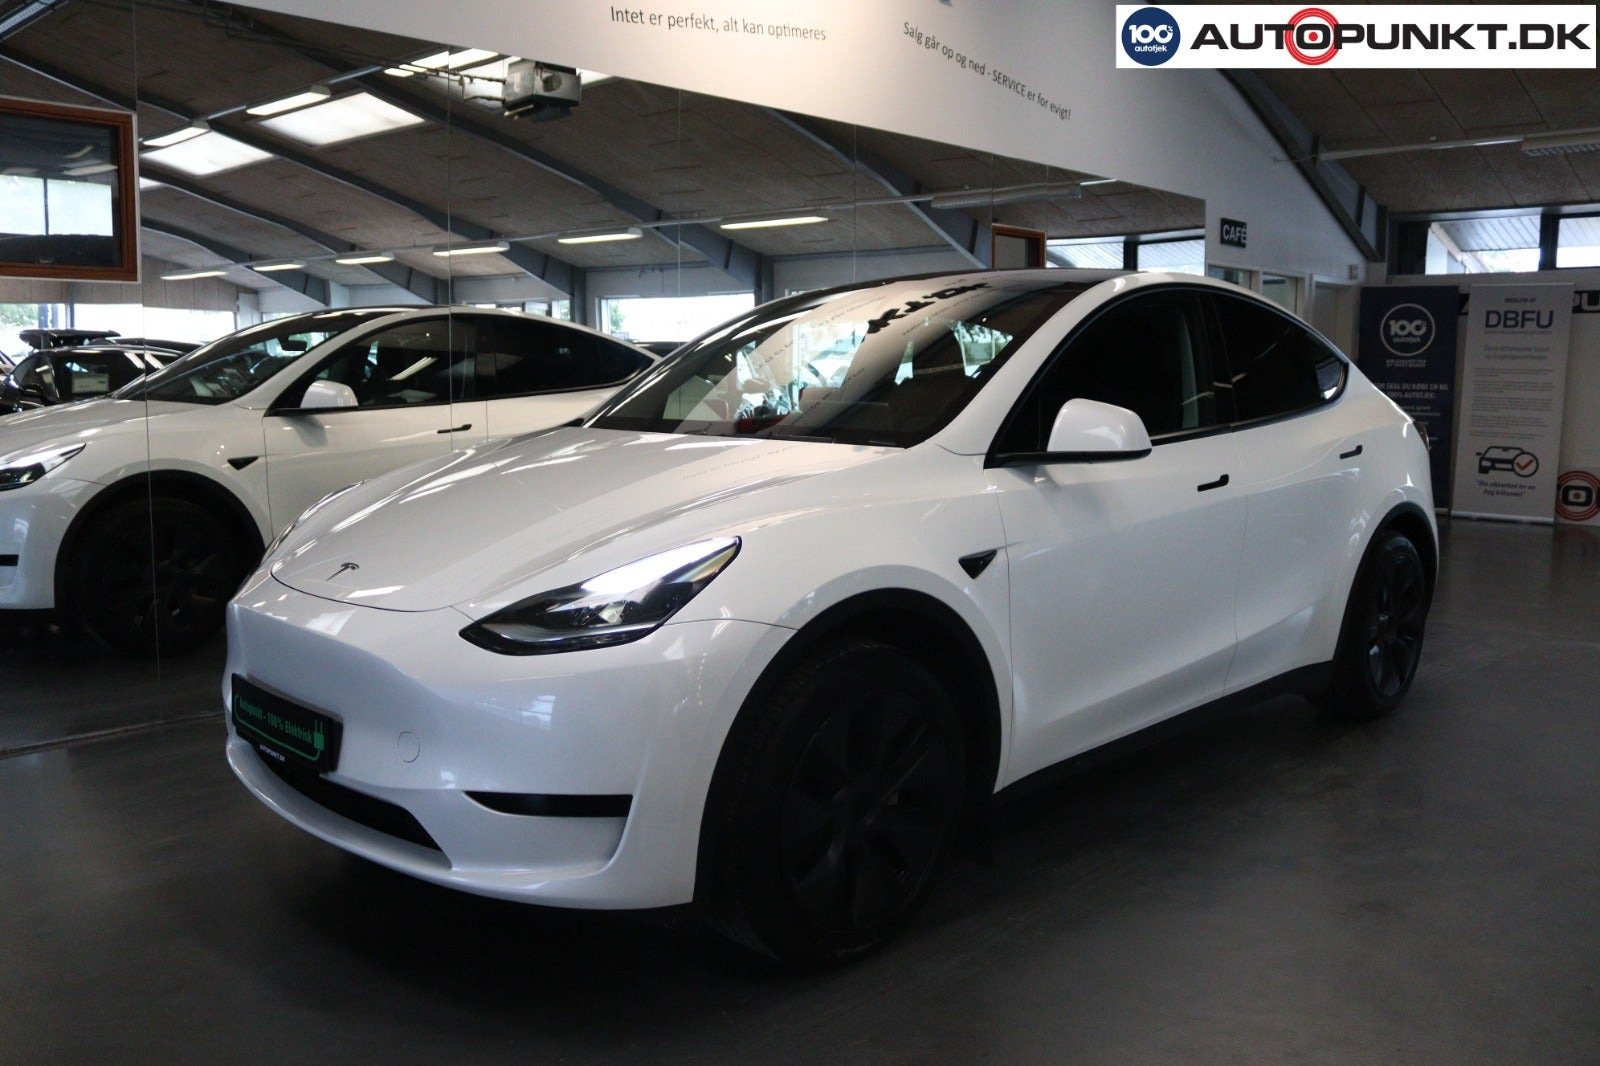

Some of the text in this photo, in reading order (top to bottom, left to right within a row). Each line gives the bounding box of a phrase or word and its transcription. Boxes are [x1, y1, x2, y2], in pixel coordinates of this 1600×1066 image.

[610, 5, 827, 41] Intet er perfekt, alt kan optimeres
[903, 21, 923, 46] Salg
[924, 35, 941, 51] går
[941, 44, 954, 61] op
[955, 52, 968, 69] og
[968, 59, 987, 76] ned
[992, 69, 1027, 98] SERVICE
[1027, 89, 1037, 101] er
[1037, 92, 1049, 109] for
[1049, 103, 1073, 121] evigt!
[1484, 310, 1555, 330] DBFU
